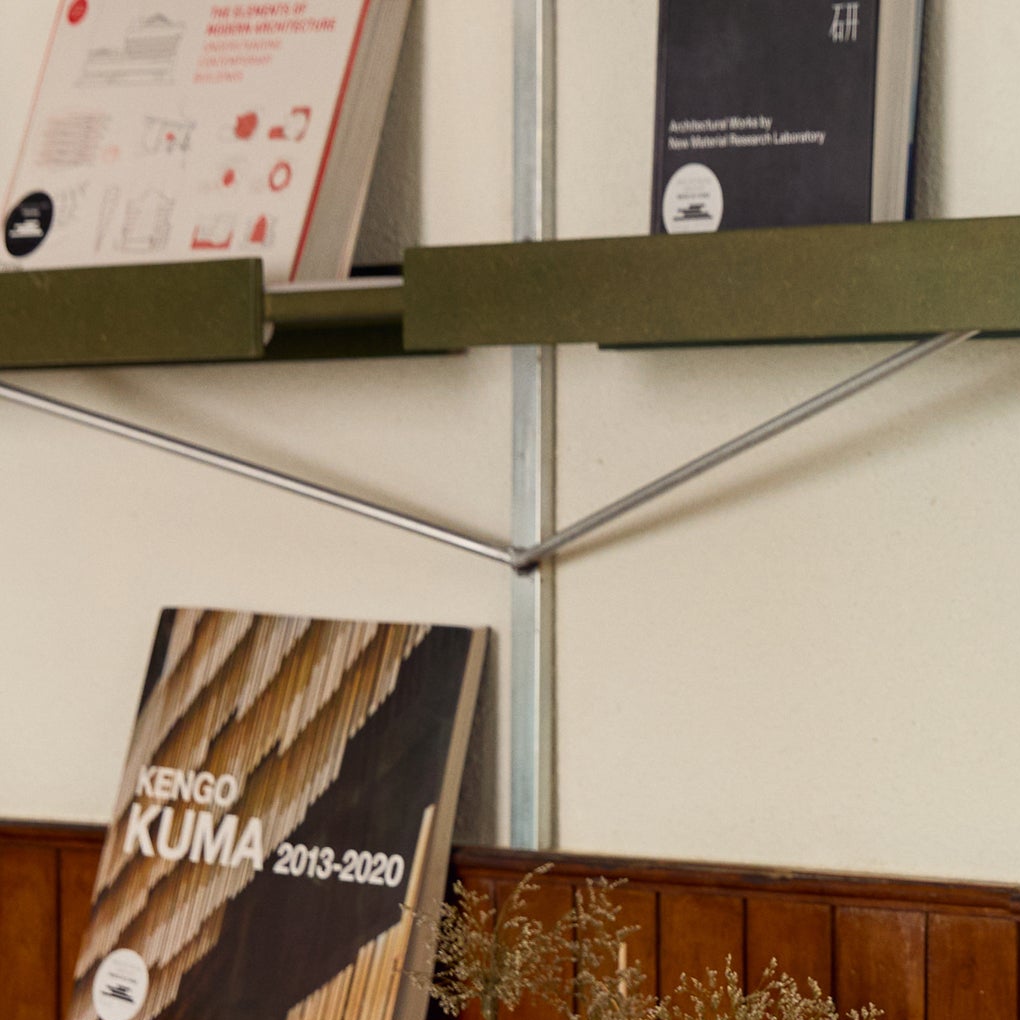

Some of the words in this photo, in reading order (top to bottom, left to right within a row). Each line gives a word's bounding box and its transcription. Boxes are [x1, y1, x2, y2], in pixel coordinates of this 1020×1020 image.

[772, 130, 826, 146] Laboratory
[135, 765, 239, 806] KENGO
[123, 802, 263, 871] KUMA
[273, 842, 405, 887] 2013-2020
